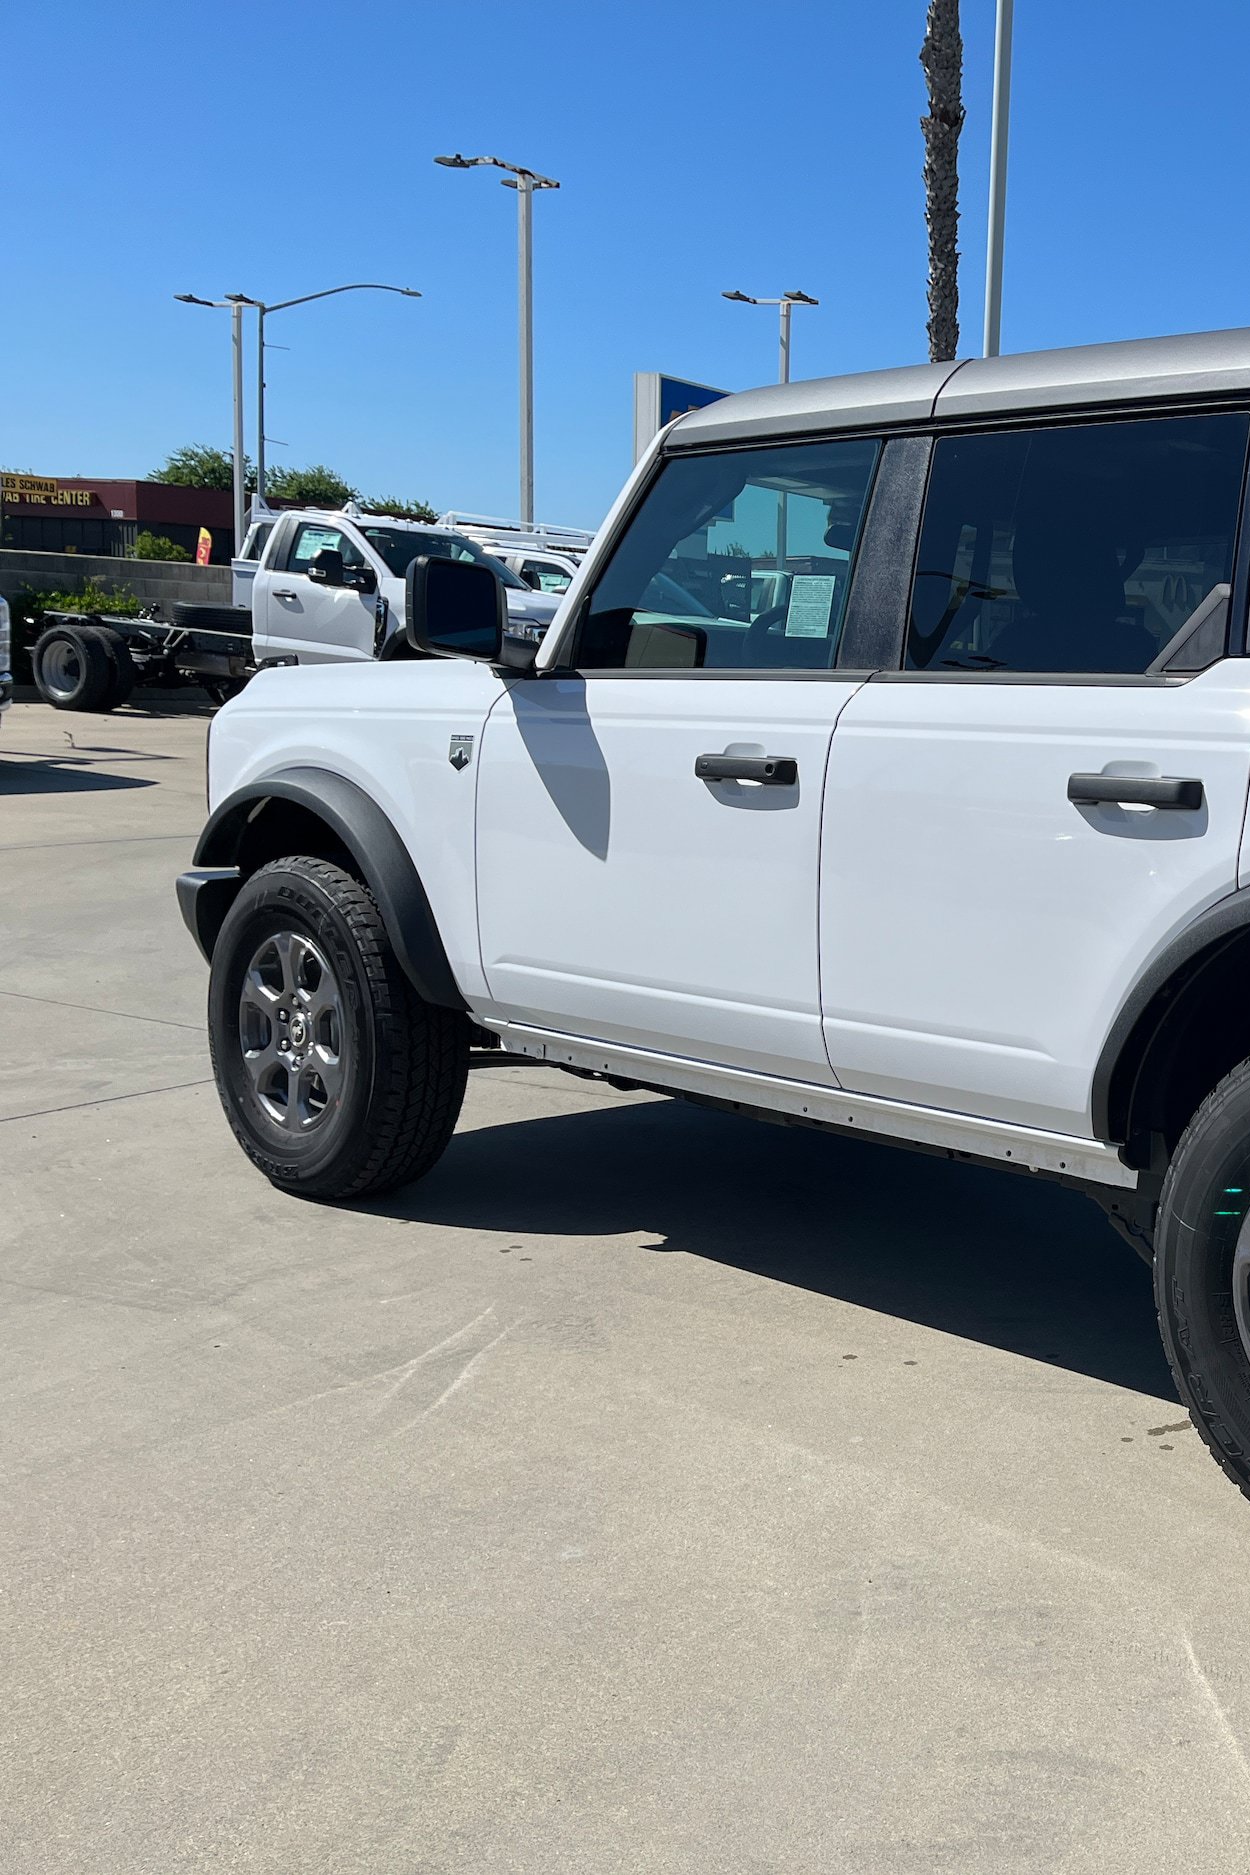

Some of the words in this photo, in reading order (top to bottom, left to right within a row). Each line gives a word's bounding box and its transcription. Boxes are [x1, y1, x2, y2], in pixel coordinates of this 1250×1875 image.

[1, 477, 16, 488] LES
[19, 479, 55, 493] SCHWAB
[50, 490, 91, 506] CENTER
